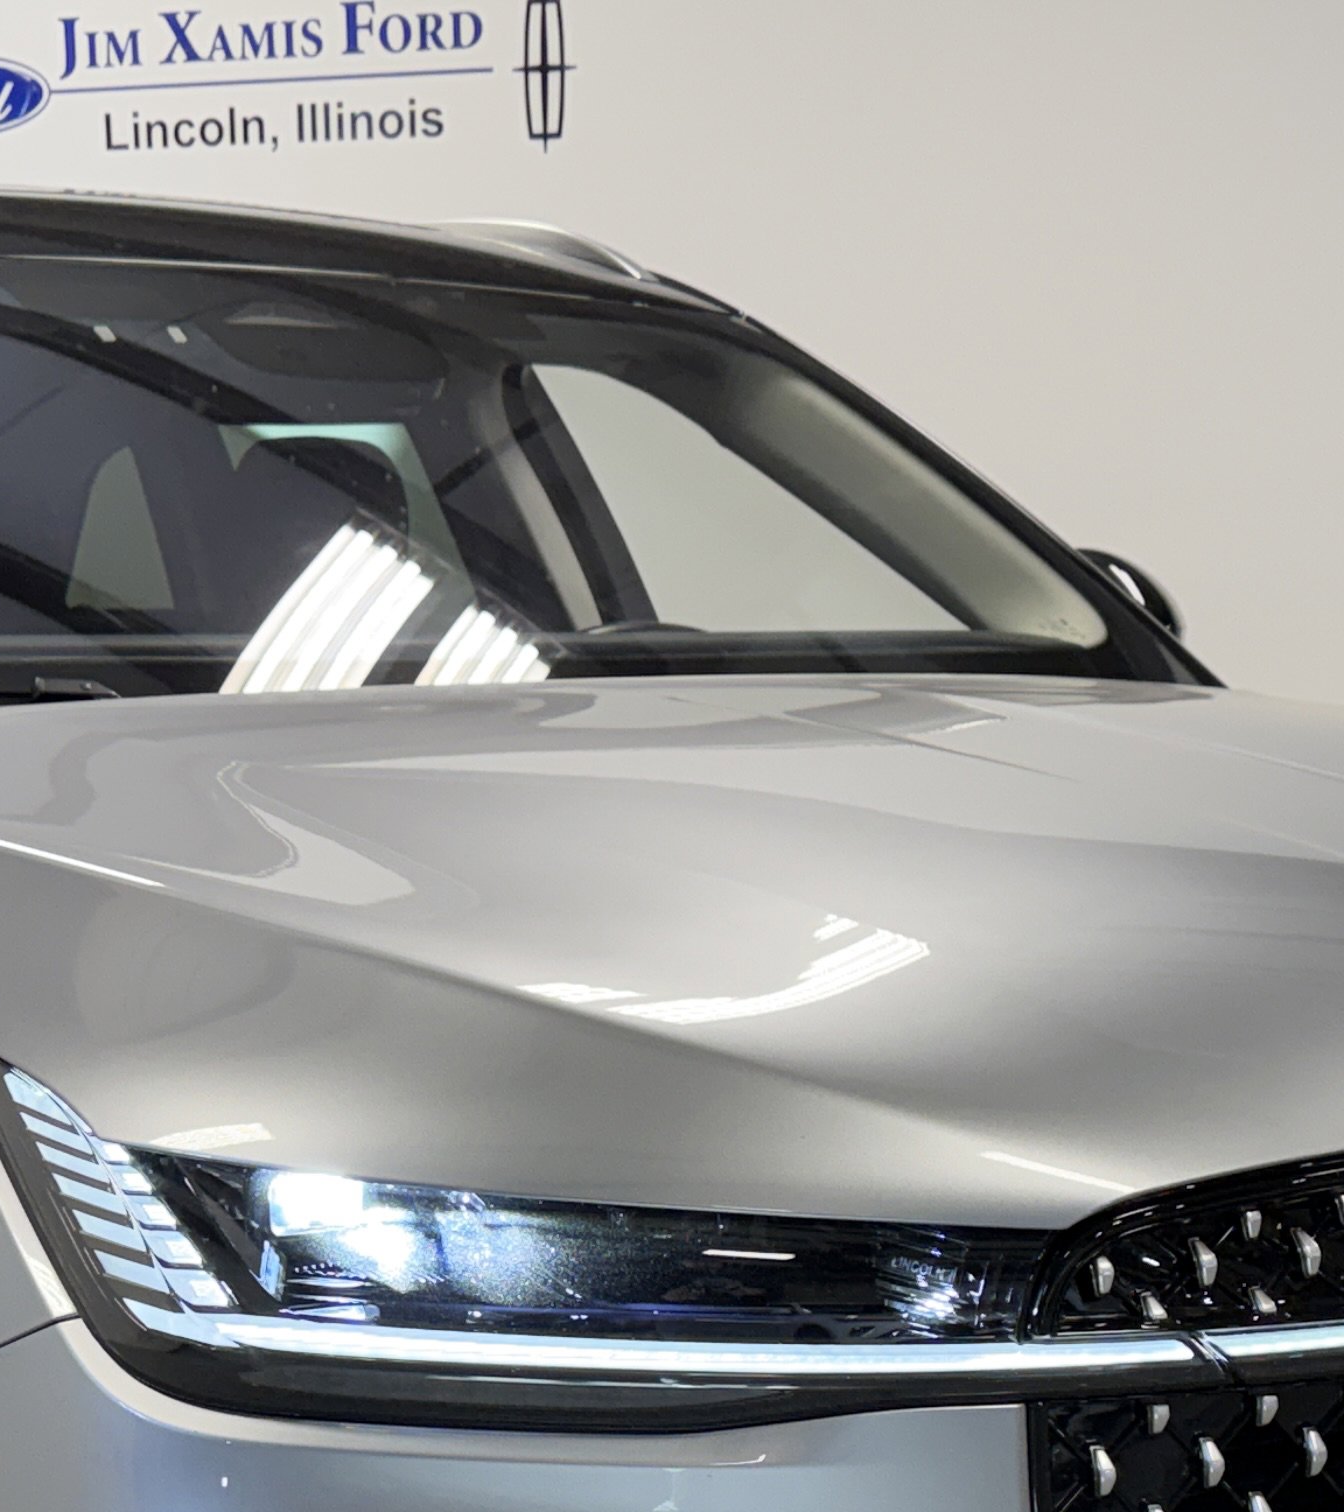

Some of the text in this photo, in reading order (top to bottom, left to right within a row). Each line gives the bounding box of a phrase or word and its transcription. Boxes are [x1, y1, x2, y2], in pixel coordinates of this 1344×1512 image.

[58, 0, 483, 80] JIM XAMIS FORD
[104, 98, 444, 152] Lincoln, Illinois
